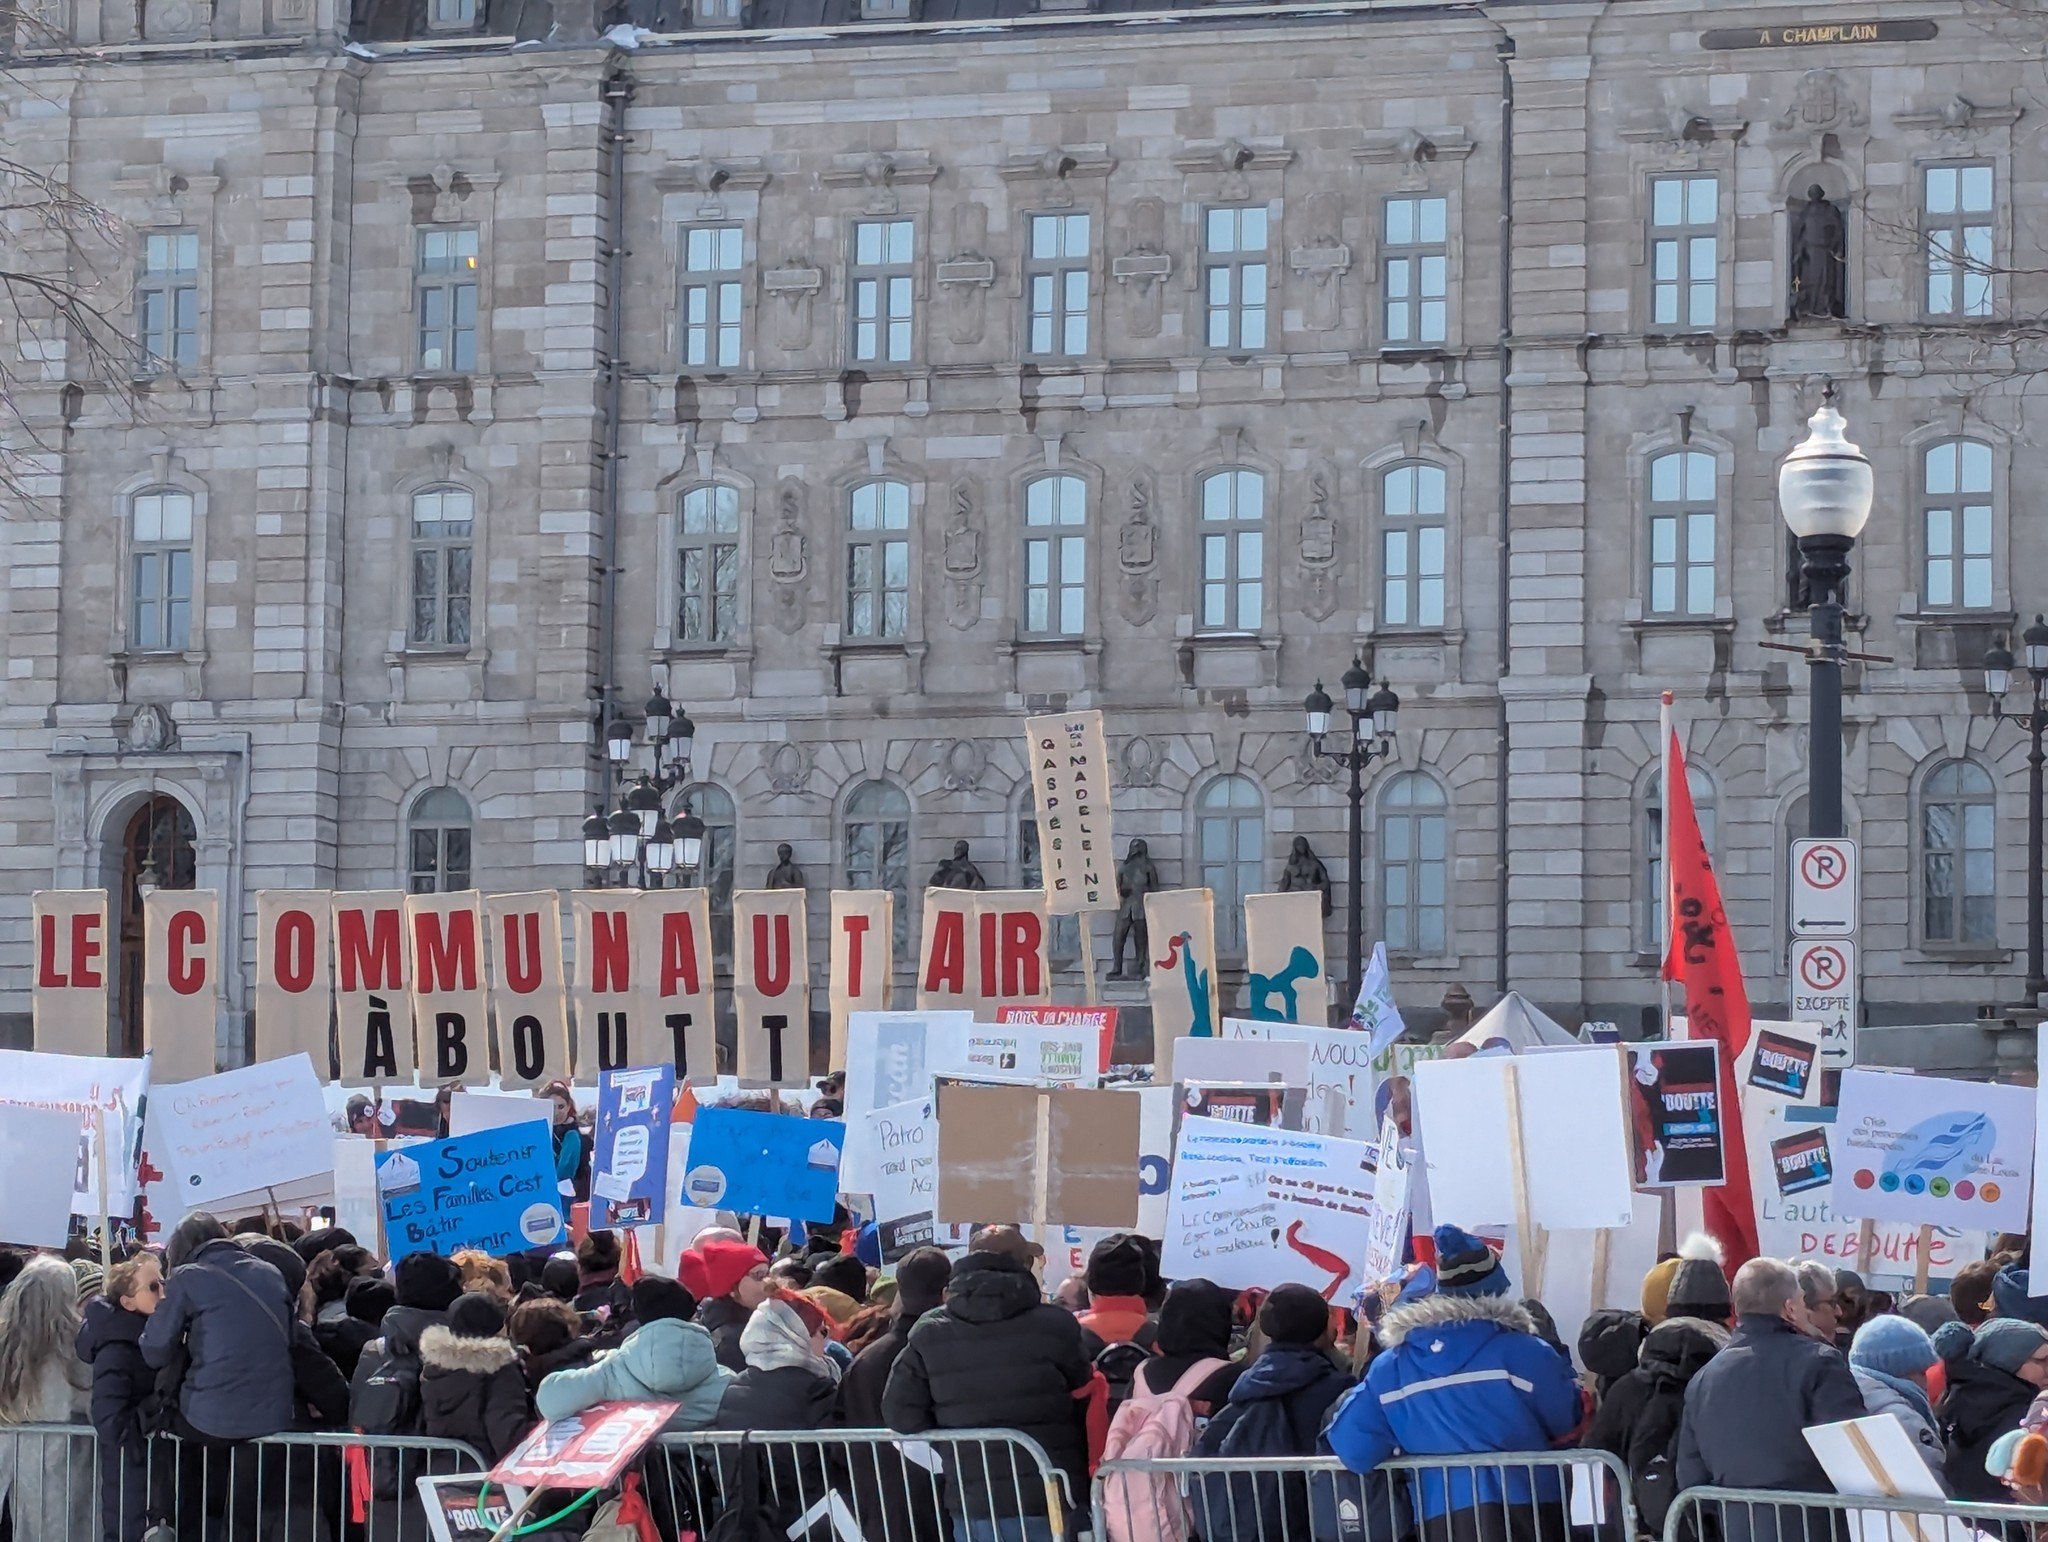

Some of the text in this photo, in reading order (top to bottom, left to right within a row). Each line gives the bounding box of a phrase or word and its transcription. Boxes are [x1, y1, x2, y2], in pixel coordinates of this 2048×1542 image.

[1782, 24, 1878, 43] CHAMPLAIN
[40, 913, 102, 988] LE
[364, 995, 397, 1078] À
[1312, 1044, 1370, 1068] NOUS
[438, 1145, 538, 1179] Soutenir
[385, 1200, 427, 1221] Les
